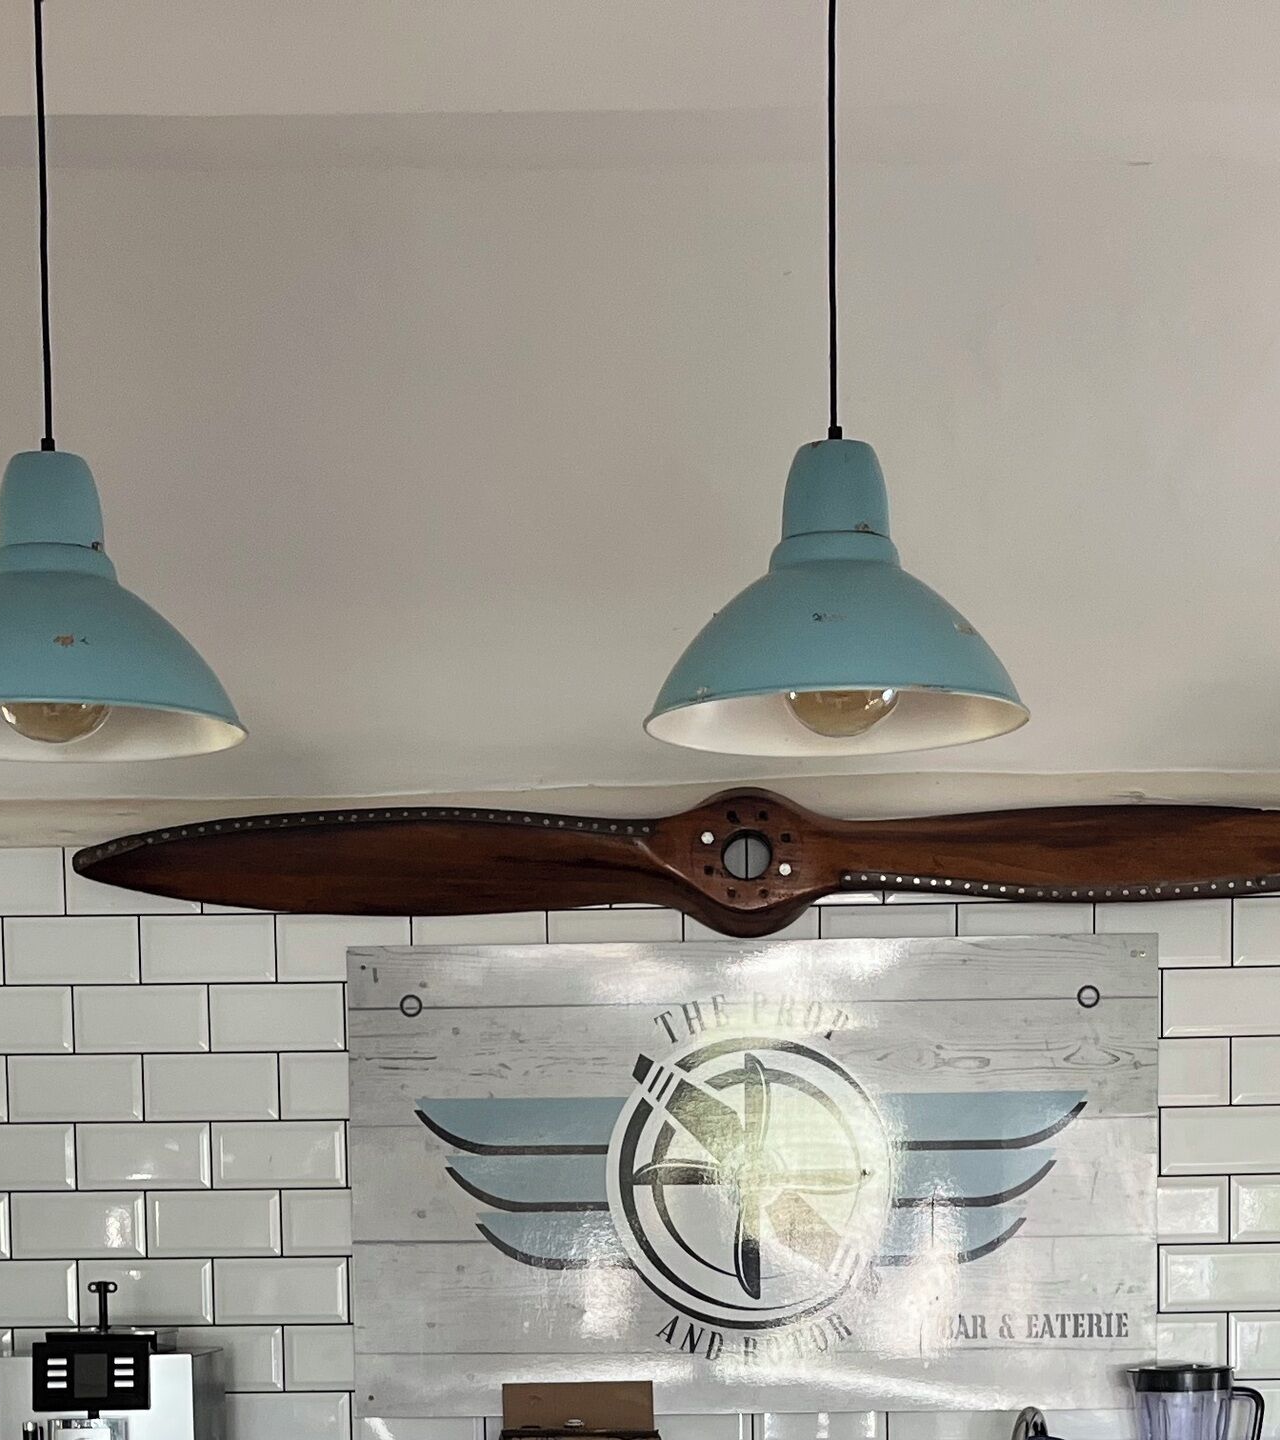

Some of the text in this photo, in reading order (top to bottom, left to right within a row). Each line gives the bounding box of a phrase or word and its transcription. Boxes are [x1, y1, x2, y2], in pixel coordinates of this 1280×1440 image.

[653, 990, 850, 1043] THE PROP
[655, 1315, 724, 1361] AND
[937, 1312, 1129, 1340] BAR & EATERIE
